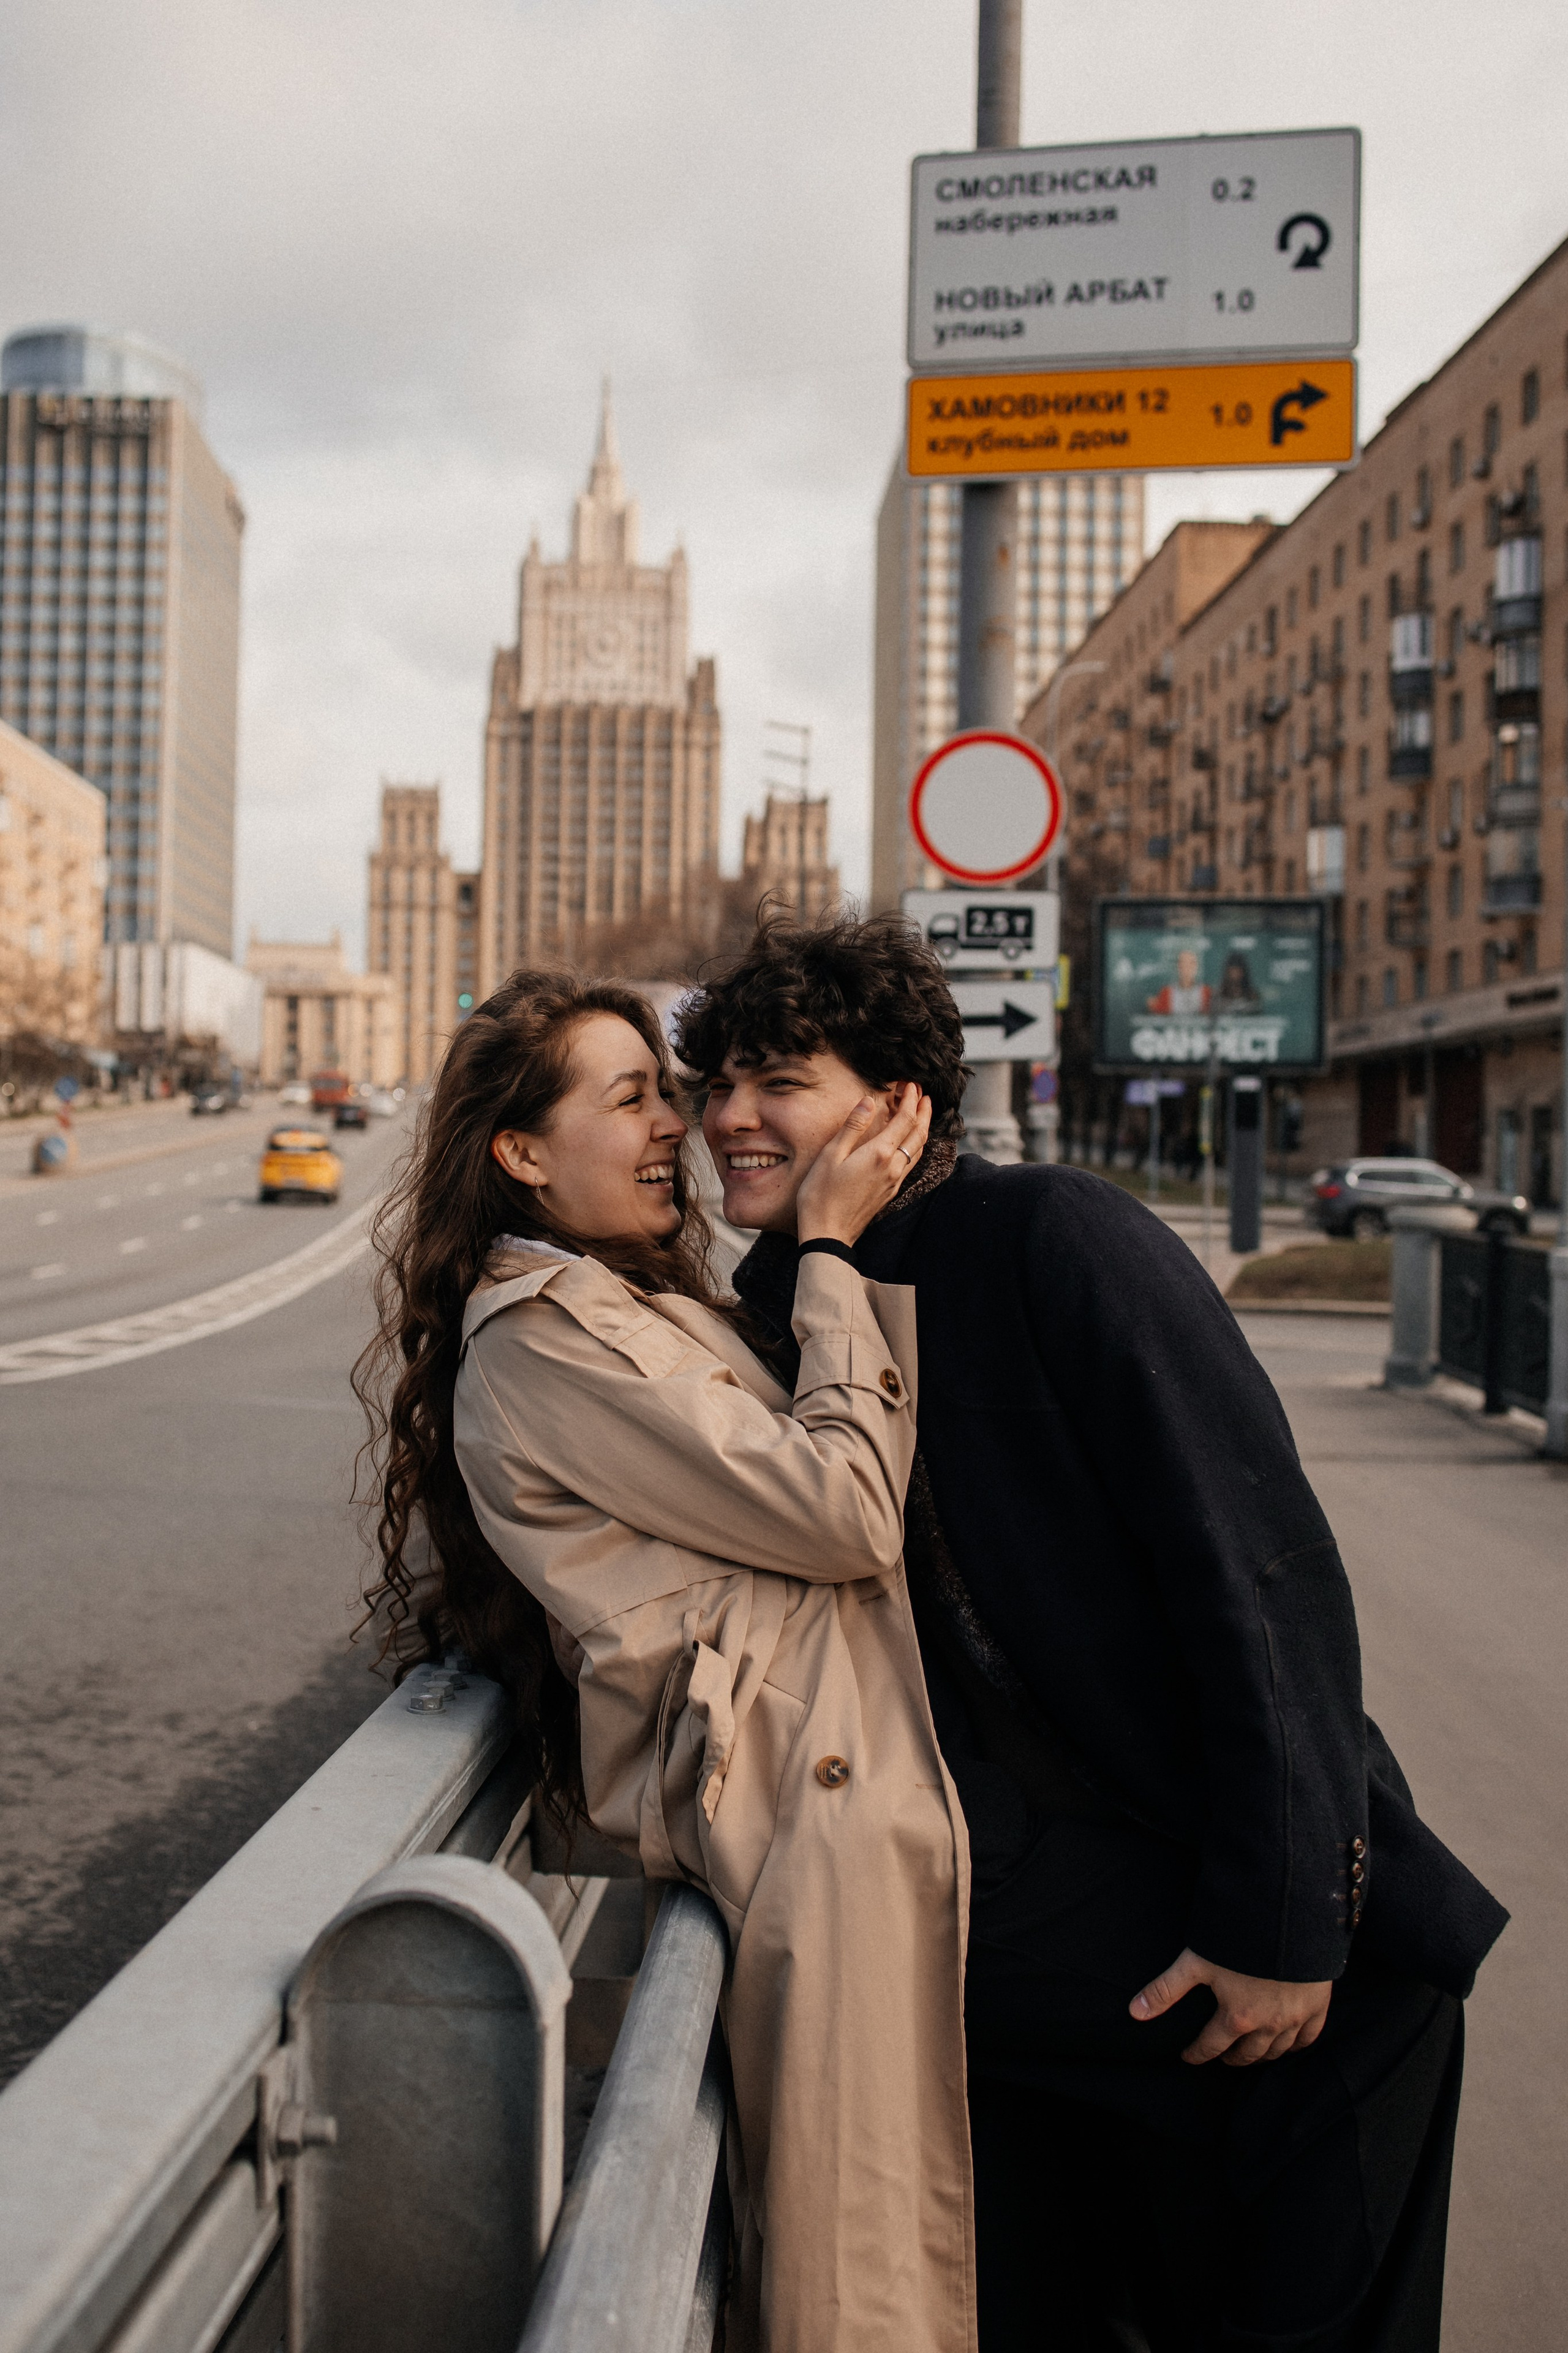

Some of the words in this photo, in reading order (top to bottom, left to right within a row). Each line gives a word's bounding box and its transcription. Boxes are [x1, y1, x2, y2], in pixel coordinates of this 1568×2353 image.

[935, 164, 1157, 202] СМОЛЕНСКАЯ
[1212, 176, 1256, 203] 0.2
[935, 206, 1118, 236] набережная
[934, 278, 1054, 312] НОВЫЙ
[1064, 276, 1168, 304] АРБАТ
[1213, 288, 1255, 314] 1.0
[934, 318, 1024, 347] улица
[929, 390, 1125, 421] ХАМОВНИКИ
[1137, 387, 1169, 414] 12
[1211, 401, 1253, 428] 1.0
[926, 426, 1059, 459] клубный
[1067, 429, 1128, 453] дом
